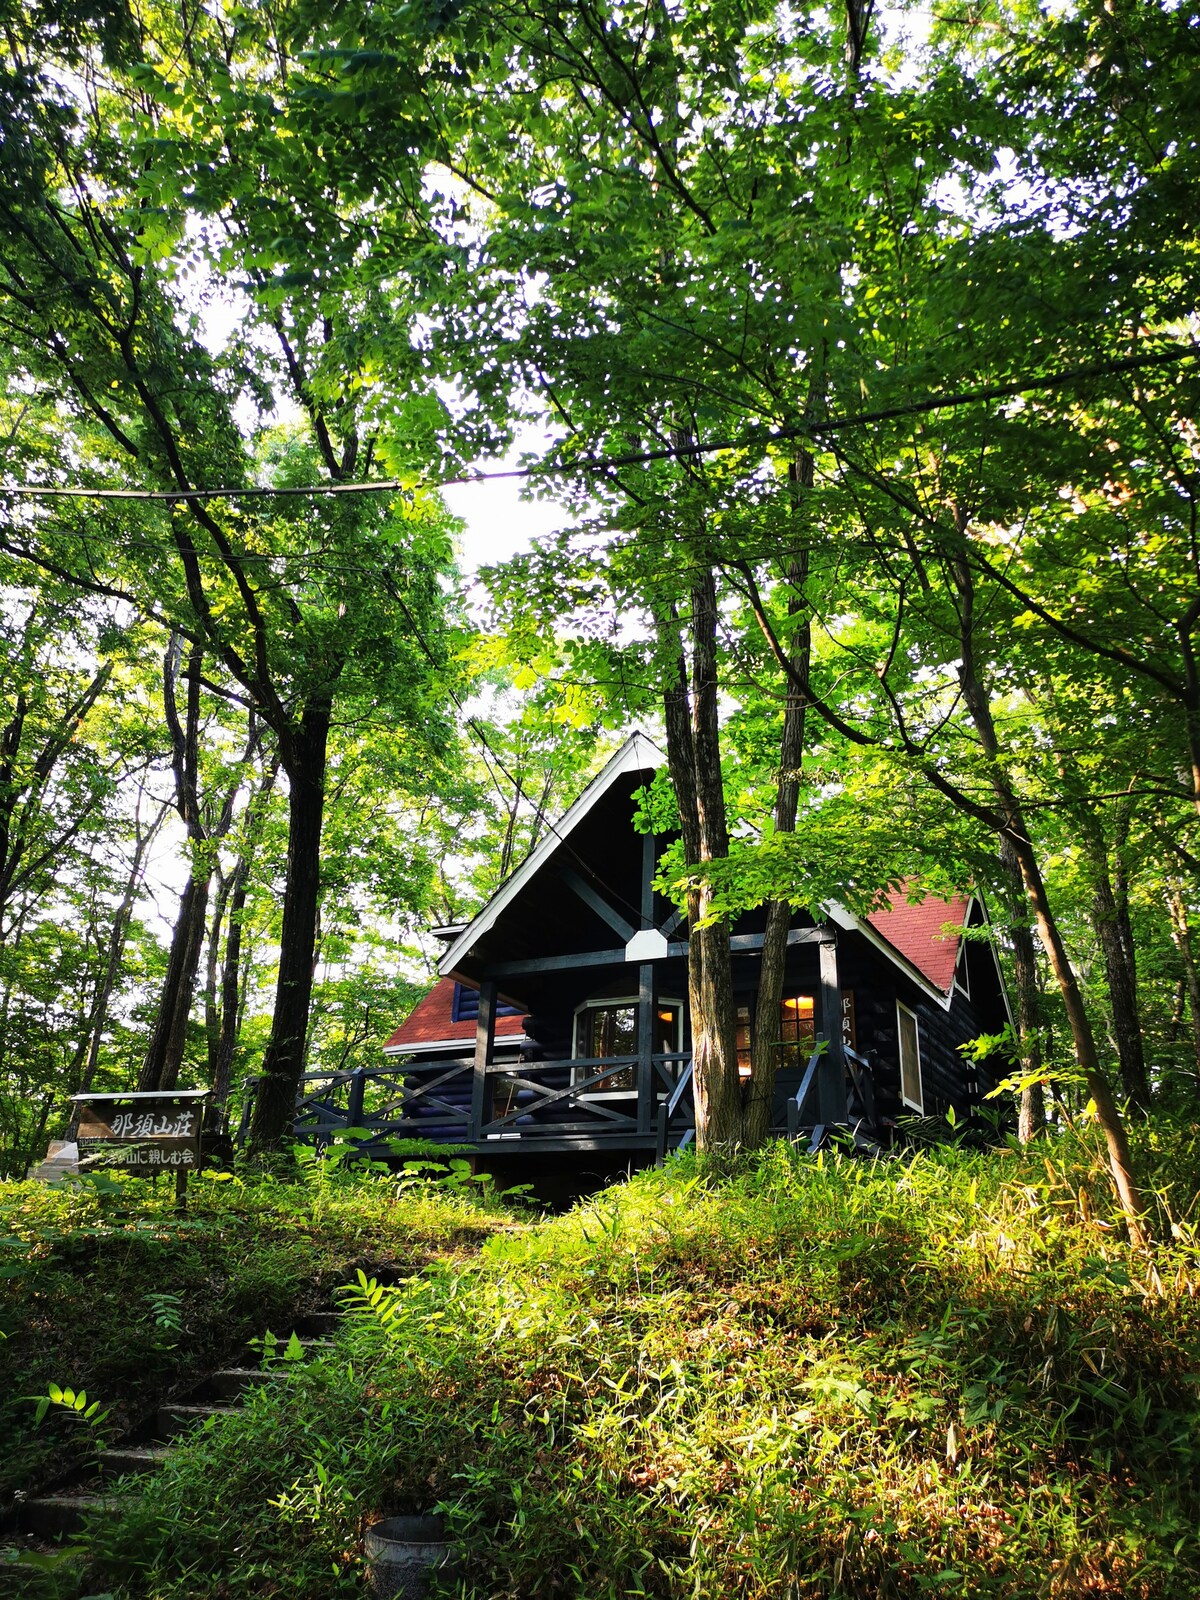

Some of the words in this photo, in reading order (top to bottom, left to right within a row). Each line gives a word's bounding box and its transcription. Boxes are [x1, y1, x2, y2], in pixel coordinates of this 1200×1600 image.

[110, 1110, 194, 1139] 那須山荘
[84, 1148, 194, 1165] 山に親しむ会
